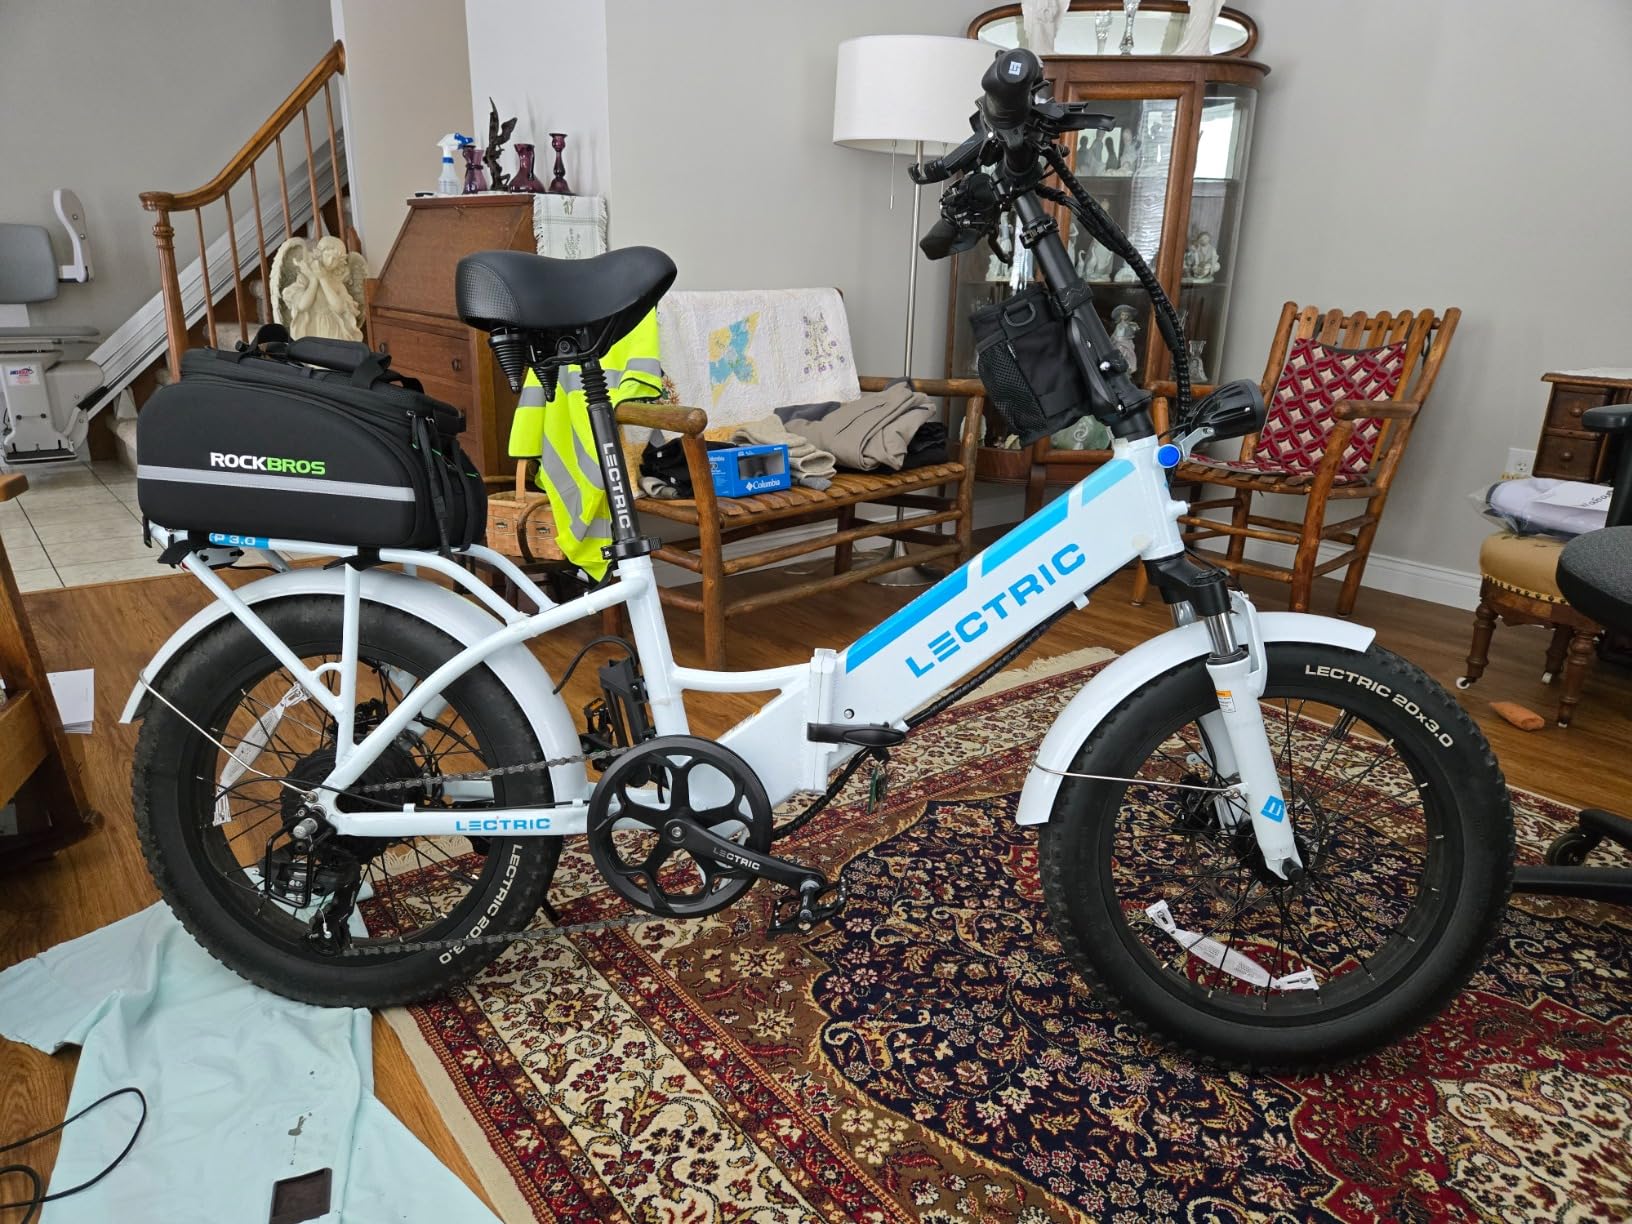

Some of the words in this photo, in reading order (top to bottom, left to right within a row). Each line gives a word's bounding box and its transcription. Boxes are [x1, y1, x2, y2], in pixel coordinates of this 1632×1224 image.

[209, 452, 326, 475] ROCKBROS
[602, 442, 631, 529] LECTRIC
[752, 479, 781, 490] Columbia
[229, 534, 256, 546] 3.0
[905, 543, 1086, 678] LECTRIC
[1305, 664, 1392, 698] LECTRIC
[1391, 694, 1454, 748] 20x3.0
[456, 818, 551, 831] LECTRIC
[713, 847, 760, 871] LECTRIC
[486, 843, 523, 917] LECTRIC
